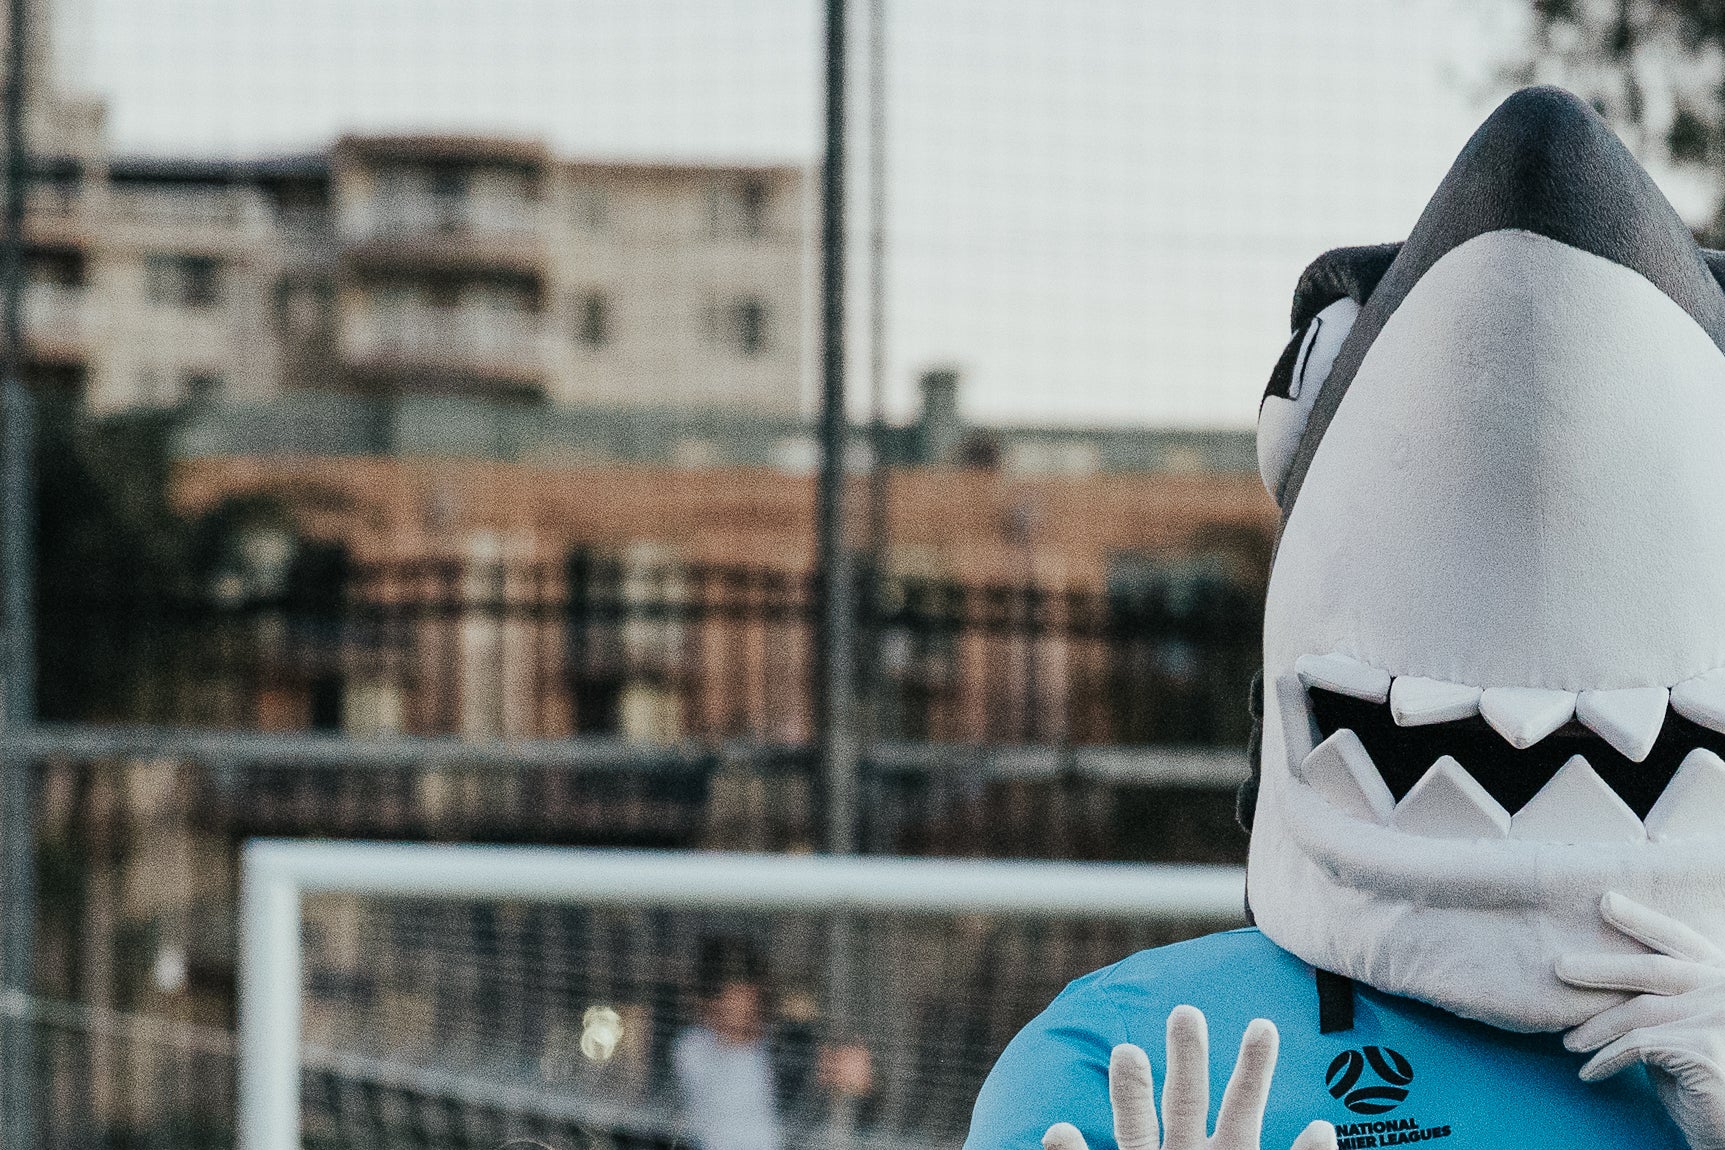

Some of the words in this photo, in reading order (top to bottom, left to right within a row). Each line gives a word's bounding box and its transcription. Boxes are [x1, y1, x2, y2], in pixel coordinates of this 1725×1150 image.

[1336, 1118, 1418, 1136] NATIONAL
[1337, 1137, 1377, 1150] MIER
[1380, 1125, 1452, 1147] LEAGUES
